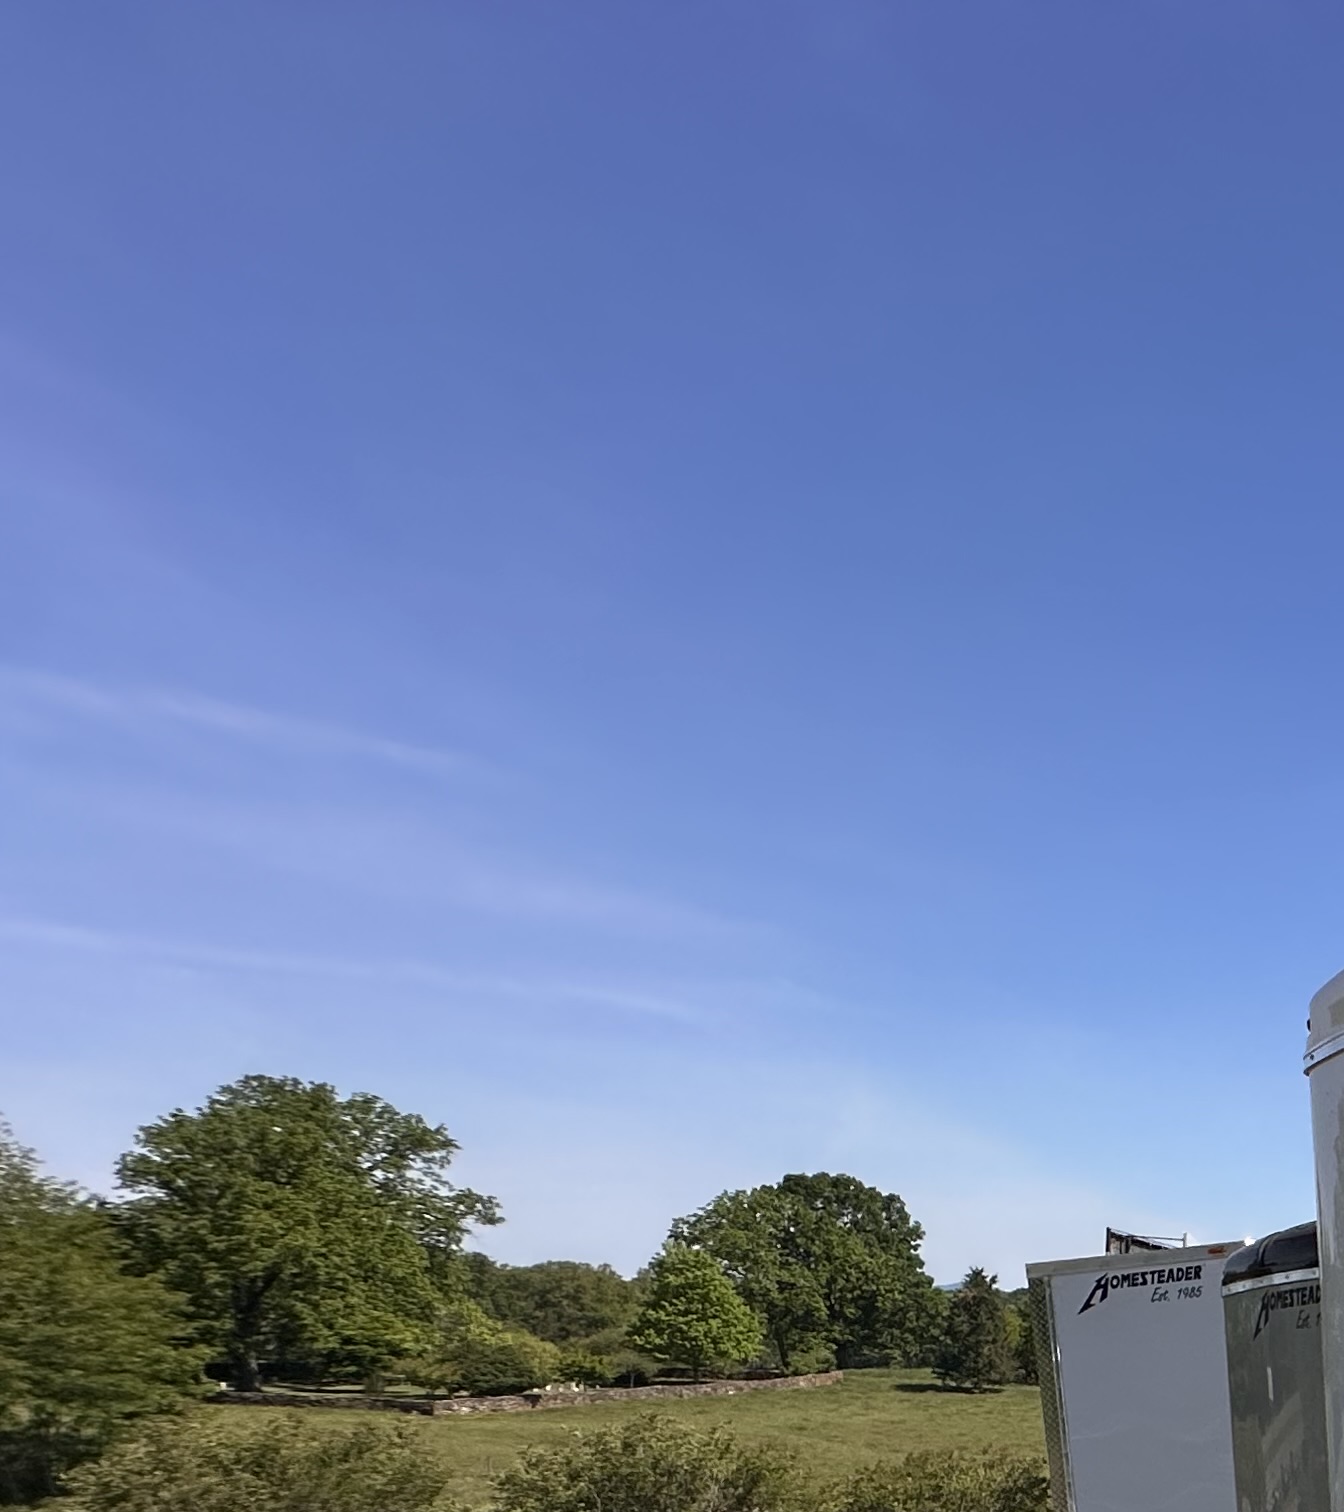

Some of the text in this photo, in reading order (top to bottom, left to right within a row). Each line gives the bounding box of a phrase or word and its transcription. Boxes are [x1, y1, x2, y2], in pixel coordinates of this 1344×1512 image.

[1077, 1265, 1202, 1315] HOMESTEADER
[1177, 1286, 1203, 1300] 1985
[1253, 1285, 1321, 1341] HOMESTEAD
